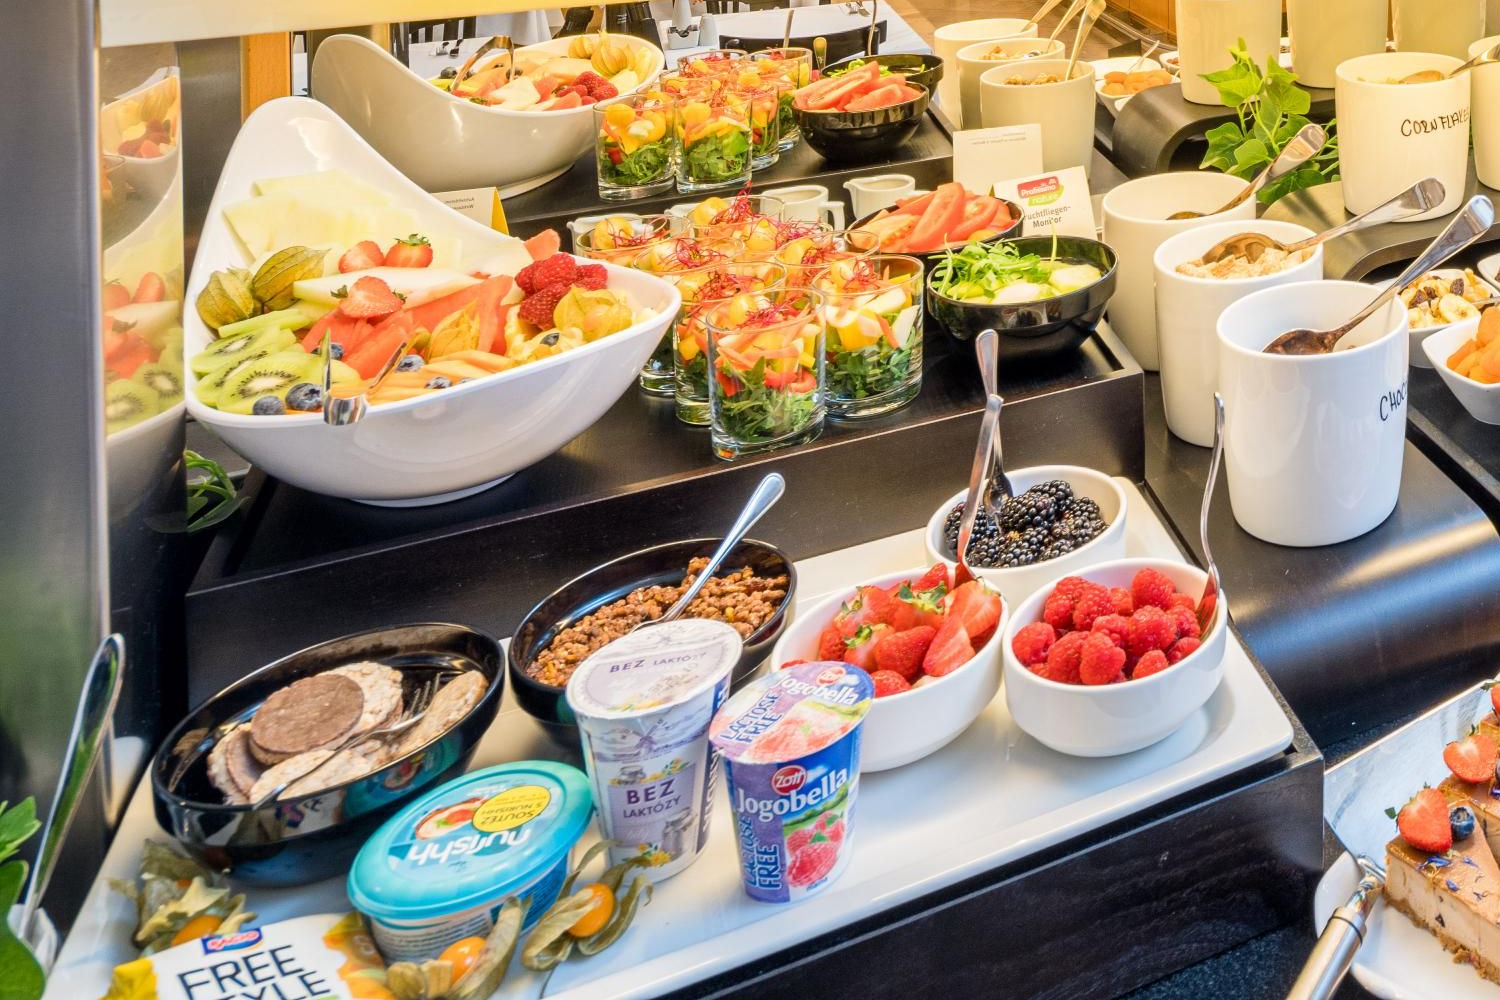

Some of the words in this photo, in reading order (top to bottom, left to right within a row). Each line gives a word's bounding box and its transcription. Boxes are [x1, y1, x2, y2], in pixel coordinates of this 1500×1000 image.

[609, 659, 646, 674] BEZ
[776, 674, 861, 706] Jogobella
[720, 692, 781, 741] LACTOSE
[735, 712, 785, 744] FREE
[626, 778, 675, 806] BEZ
[737, 768, 849, 823] Jogobella
[775, 772, 807, 789] Zott
[623, 796, 682, 819] LAKTÓZY
[405, 828, 532, 866] nurishh
[757, 844, 782, 891] FREE
[177, 944, 304, 1000] FREE
